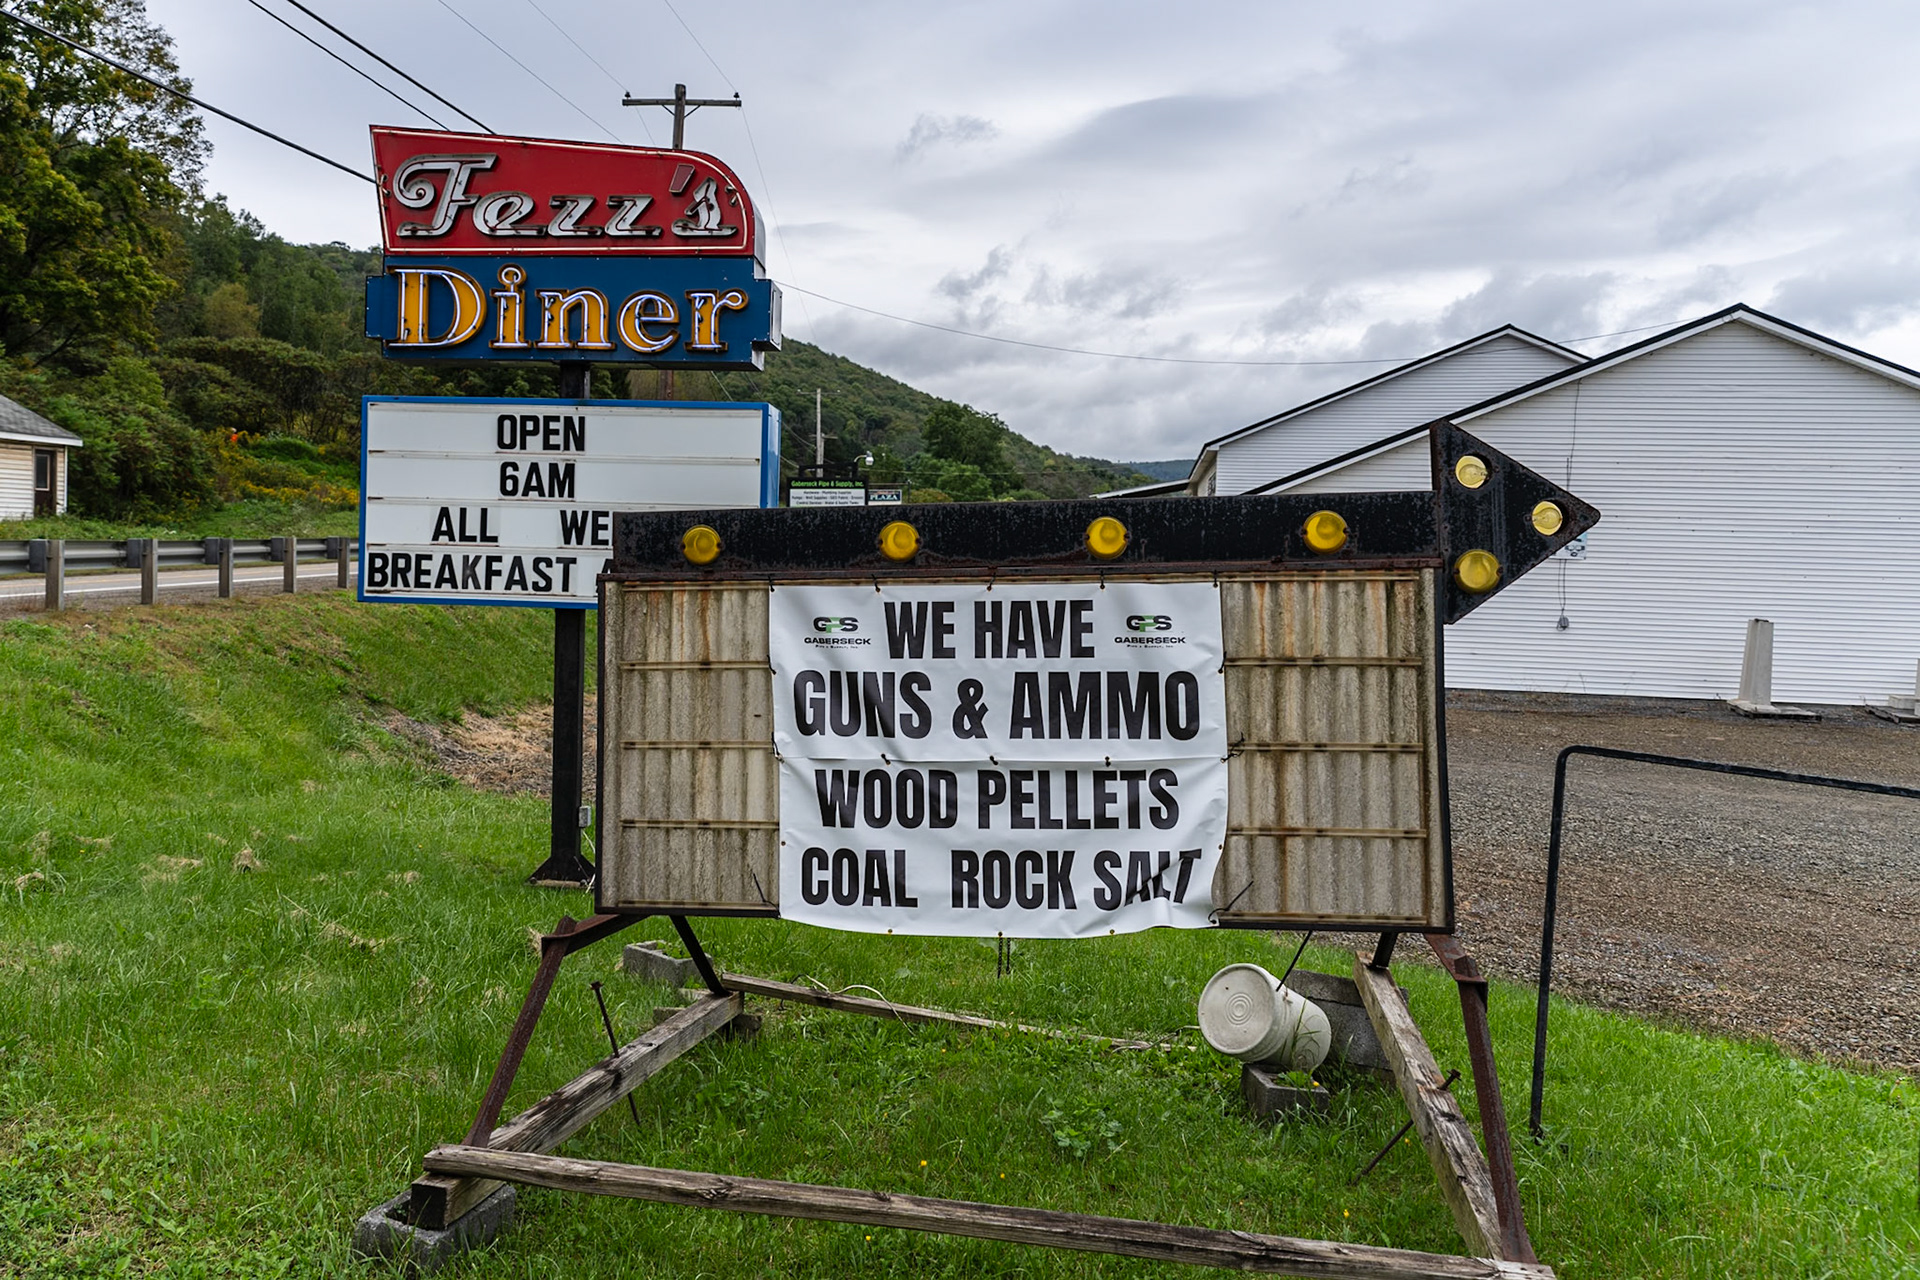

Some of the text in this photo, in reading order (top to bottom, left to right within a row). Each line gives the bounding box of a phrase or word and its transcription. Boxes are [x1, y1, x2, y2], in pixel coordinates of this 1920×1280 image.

[393, 153, 738, 237] Fezz's
[384, 263, 749, 352] Diner
[497, 414, 586, 452] OPEN
[500, 461, 576, 498] 6AM
[432, 506, 498, 543] ALL
[367, 552, 577, 593] BREAKFAST
[804, 637, 871, 646] GABERSECK
[884, 599, 1095, 659] WE HAVE
[1114, 636, 1186, 645] GABERSECK
[793, 670, 1200, 741] GUNS & AMMO
[815, 768, 1179, 830] WOOD PELLETS
[801, 847, 1202, 911] COAL ROCK SALT
